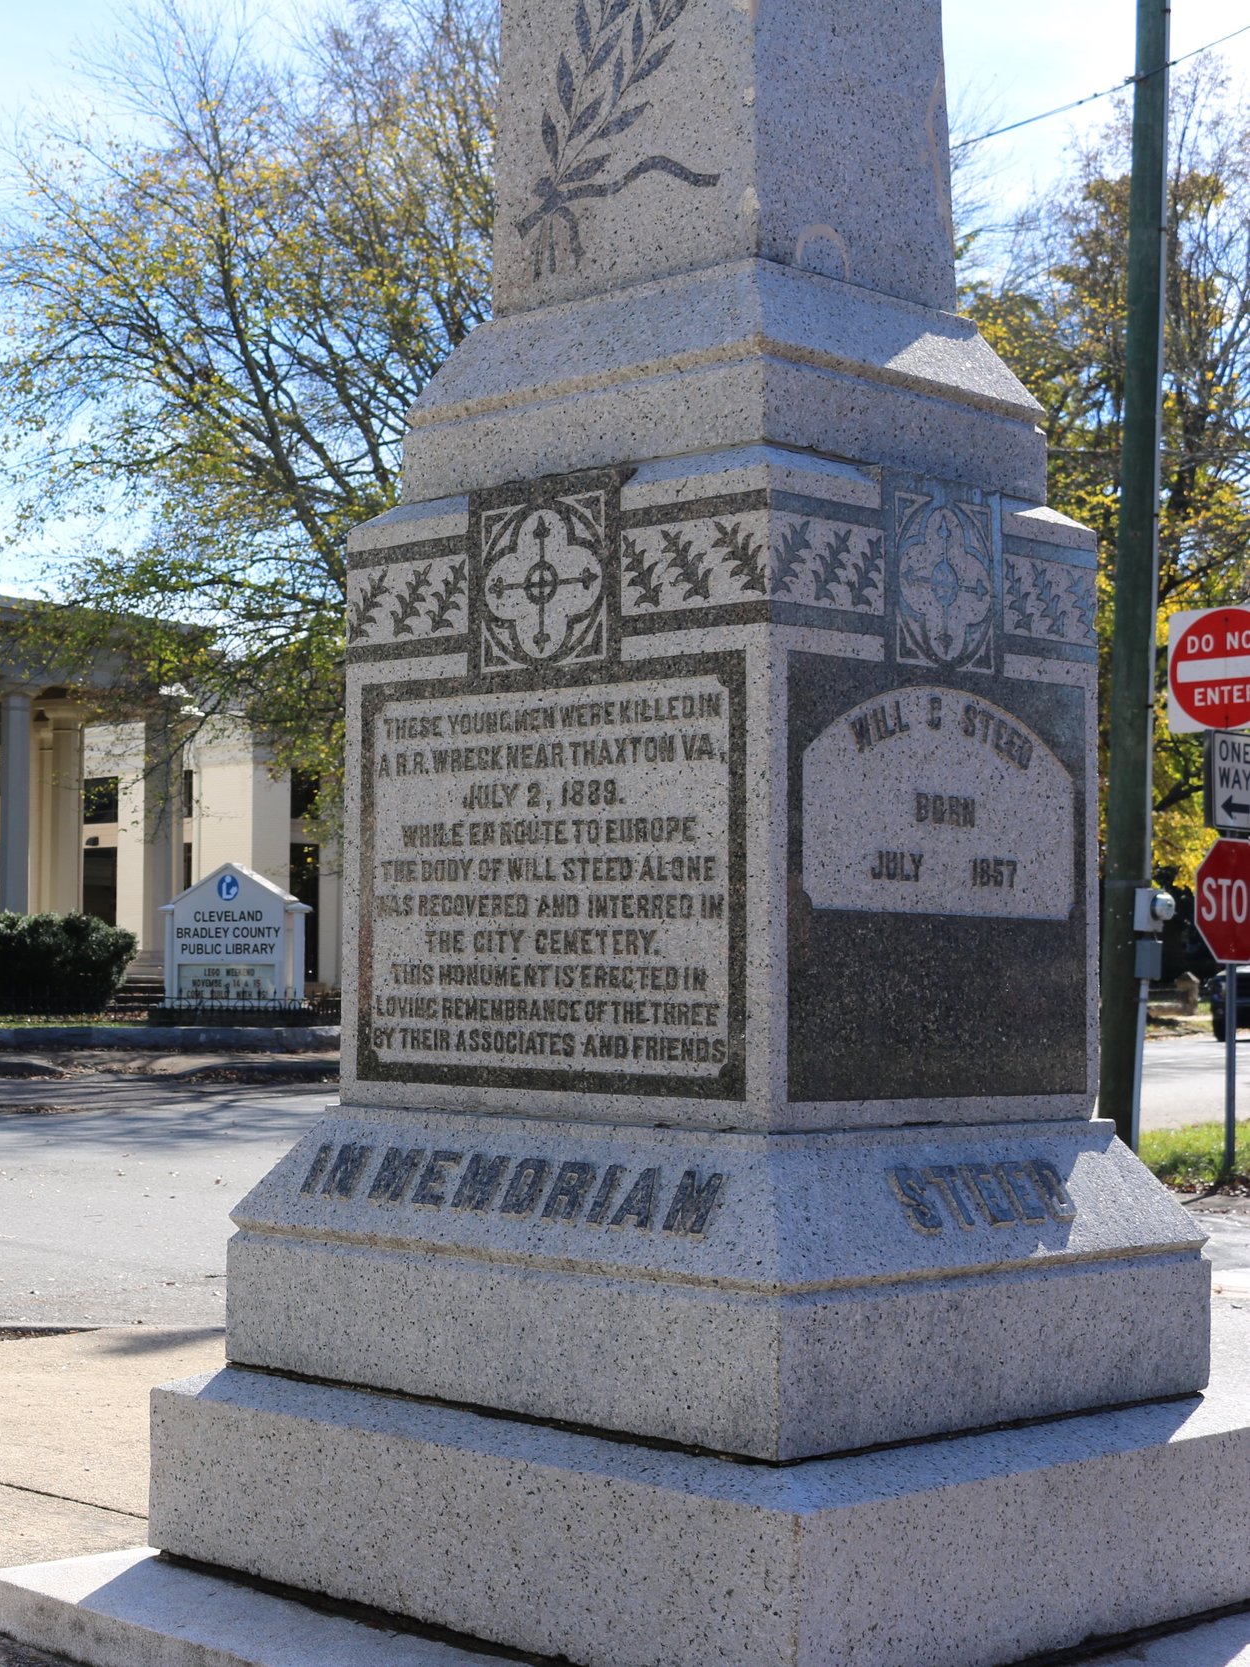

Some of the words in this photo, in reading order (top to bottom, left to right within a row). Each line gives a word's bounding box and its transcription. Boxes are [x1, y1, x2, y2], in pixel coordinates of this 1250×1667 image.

[1187, 634, 1214, 654] DO
[383, 716, 443, 740] THESE
[448, 710, 512, 735] YOUNG
[515, 705, 554, 731] MEN
[559, 702, 615, 727] WERE
[620, 695, 694, 724] KILLED
[699, 692, 723, 718] IN
[851, 701, 910, 752] WILL
[963, 704, 1033, 770] STEED
[379, 753, 390, 778] A
[396, 751, 429, 776] R.R.
[432, 746, 503, 774] WRECK
[506, 742, 563, 770] NEAR
[569, 735, 674, 767] THAXTON
[1219, 739, 1250, 764] ONE
[1219, 766, 1250, 791] WAY
[462, 784, 519, 809] JULY
[527, 783, 550, 813] 2,
[916, 793, 975, 828] BORN
[401, 822, 464, 847] WHILE
[469, 821, 495, 846] EN
[501, 820, 569, 846] ROUTE
[572, 819, 600, 844] TO
[606, 816, 697, 844] EUROPE
[381, 859, 417, 882] THE
[421, 859, 473, 882] BODY
[479, 858, 504, 881] OF
[508, 857, 557, 882] WILL
[562, 857, 632, 881] STEED
[639, 855, 716, 882] ALONE
[871, 851, 924, 882] JULY
[972, 858, 1017, 888] 1857
[194, 910, 263, 923] CLEVELAND
[375, 894, 413, 917] WAS
[418, 894, 528, 918] RECOVERED
[536, 894, 579, 918] AND
[588, 894, 693, 919] INTERRED
[701, 894, 725, 919] IN
[176, 927, 230, 939] BRADLEY
[232, 926, 281, 939] COUNTY
[425, 930, 464, 953] THE
[473, 930, 525, 954] CITY
[535, 929, 660, 955] CEMETERY.
[181, 943, 222, 955] PUBLIC
[225, 943, 275, 955] LIBRARY
[391, 963, 434, 986] THIS
[439, 963, 550, 988] MONUMENT
[554, 965, 574, 988] IS
[580, 965, 678, 990] ERECTED
[684, 967, 707, 990] IN
[376, 996, 438, 1019] LOVING
[442, 997, 581, 1022] REMEMBRANCE
[585, 1000, 607, 1022] OF
[611, 1001, 647, 1024] THE
[650, 1002, 719, 1027] THREE
[373, 1027, 395, 1050] BY
[399, 1028, 450, 1051] THEIR
[456, 1029, 576, 1058] ASSOCIATES
[583, 1034, 628, 1059] AND
[632, 1036, 727, 1063] FRIENDS
[300, 1143, 373, 1199] IN
[368, 1147, 725, 1236] MEMORIAM
[885, 1159, 1077, 1236] STEED
